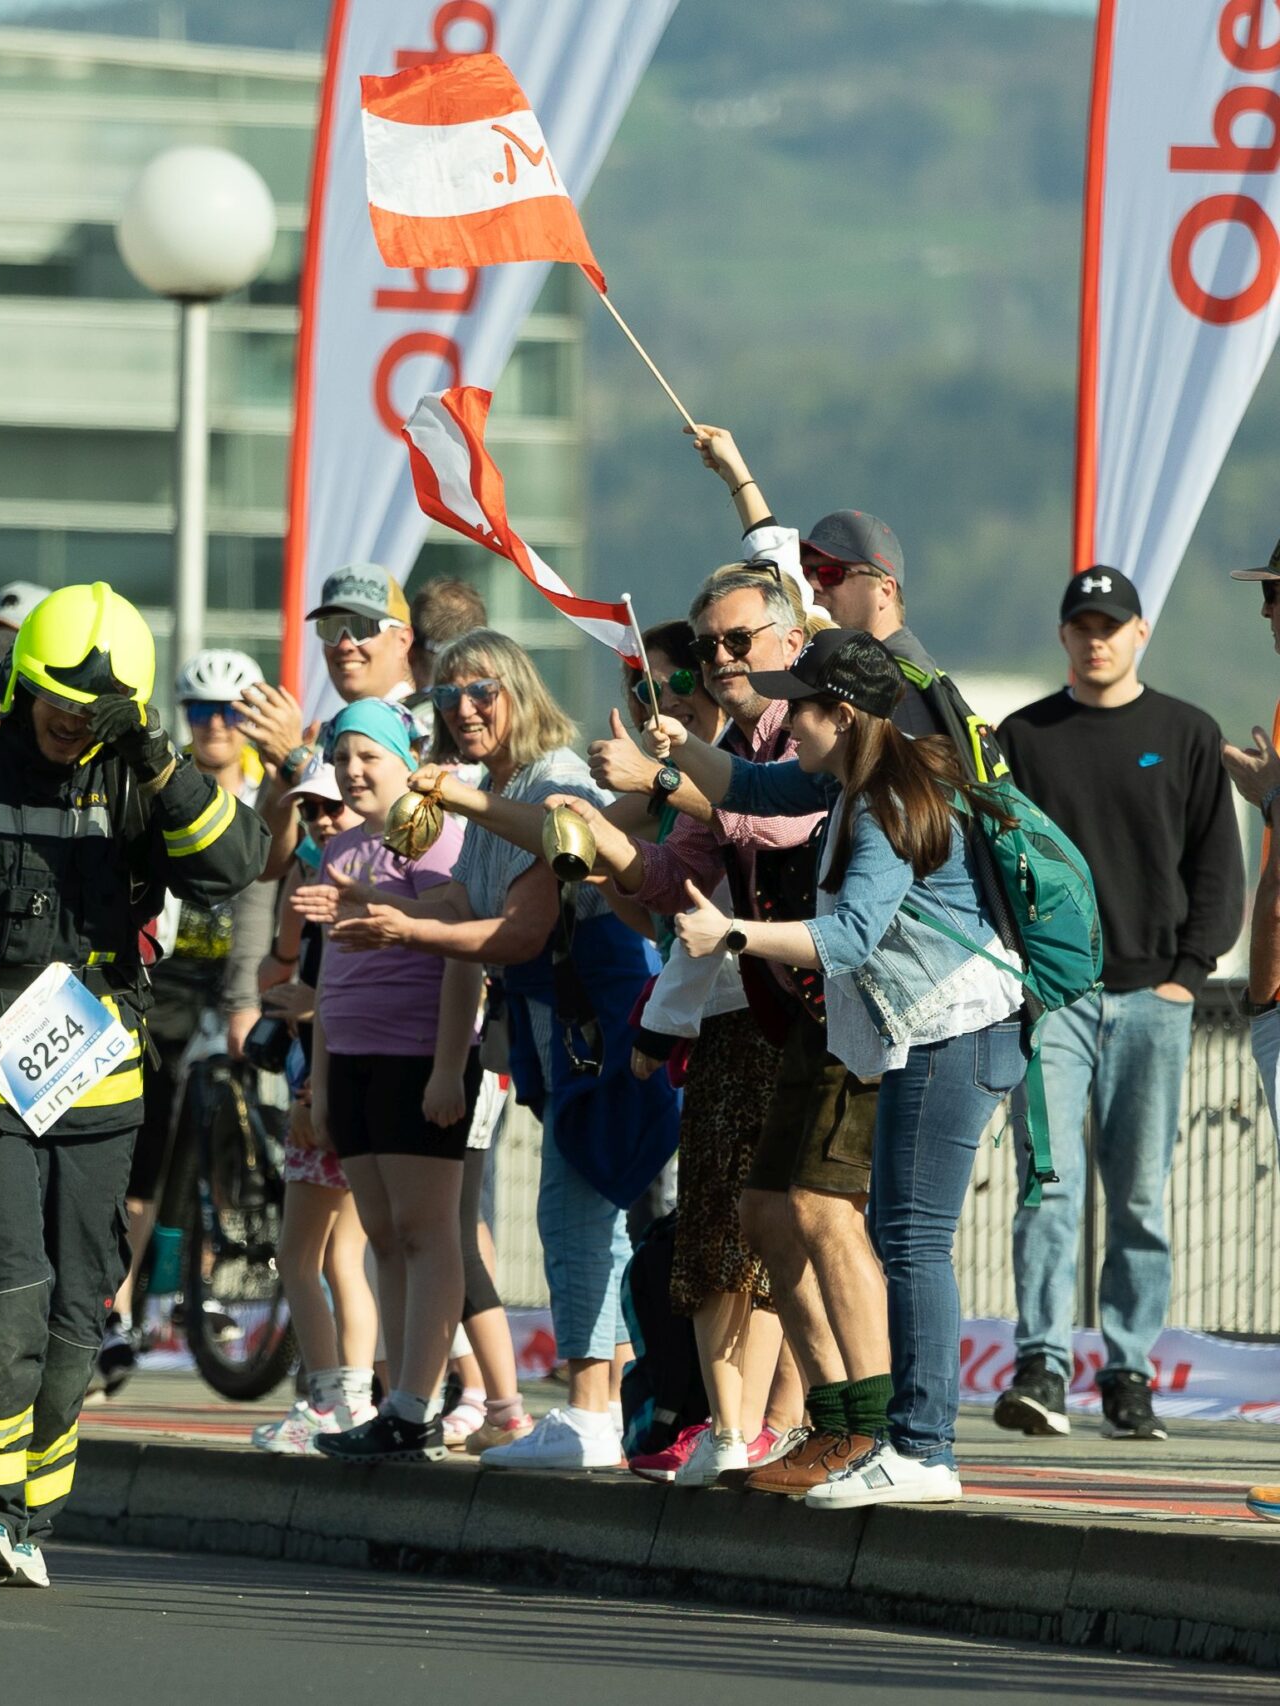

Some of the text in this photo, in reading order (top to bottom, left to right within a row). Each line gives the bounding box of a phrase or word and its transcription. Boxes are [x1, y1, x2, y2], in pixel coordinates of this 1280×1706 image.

[18, 1014, 85, 1082] 8254
[22, 1017, 50, 1045] Manuel
[33, 1036, 126, 1125] LINZ AG
